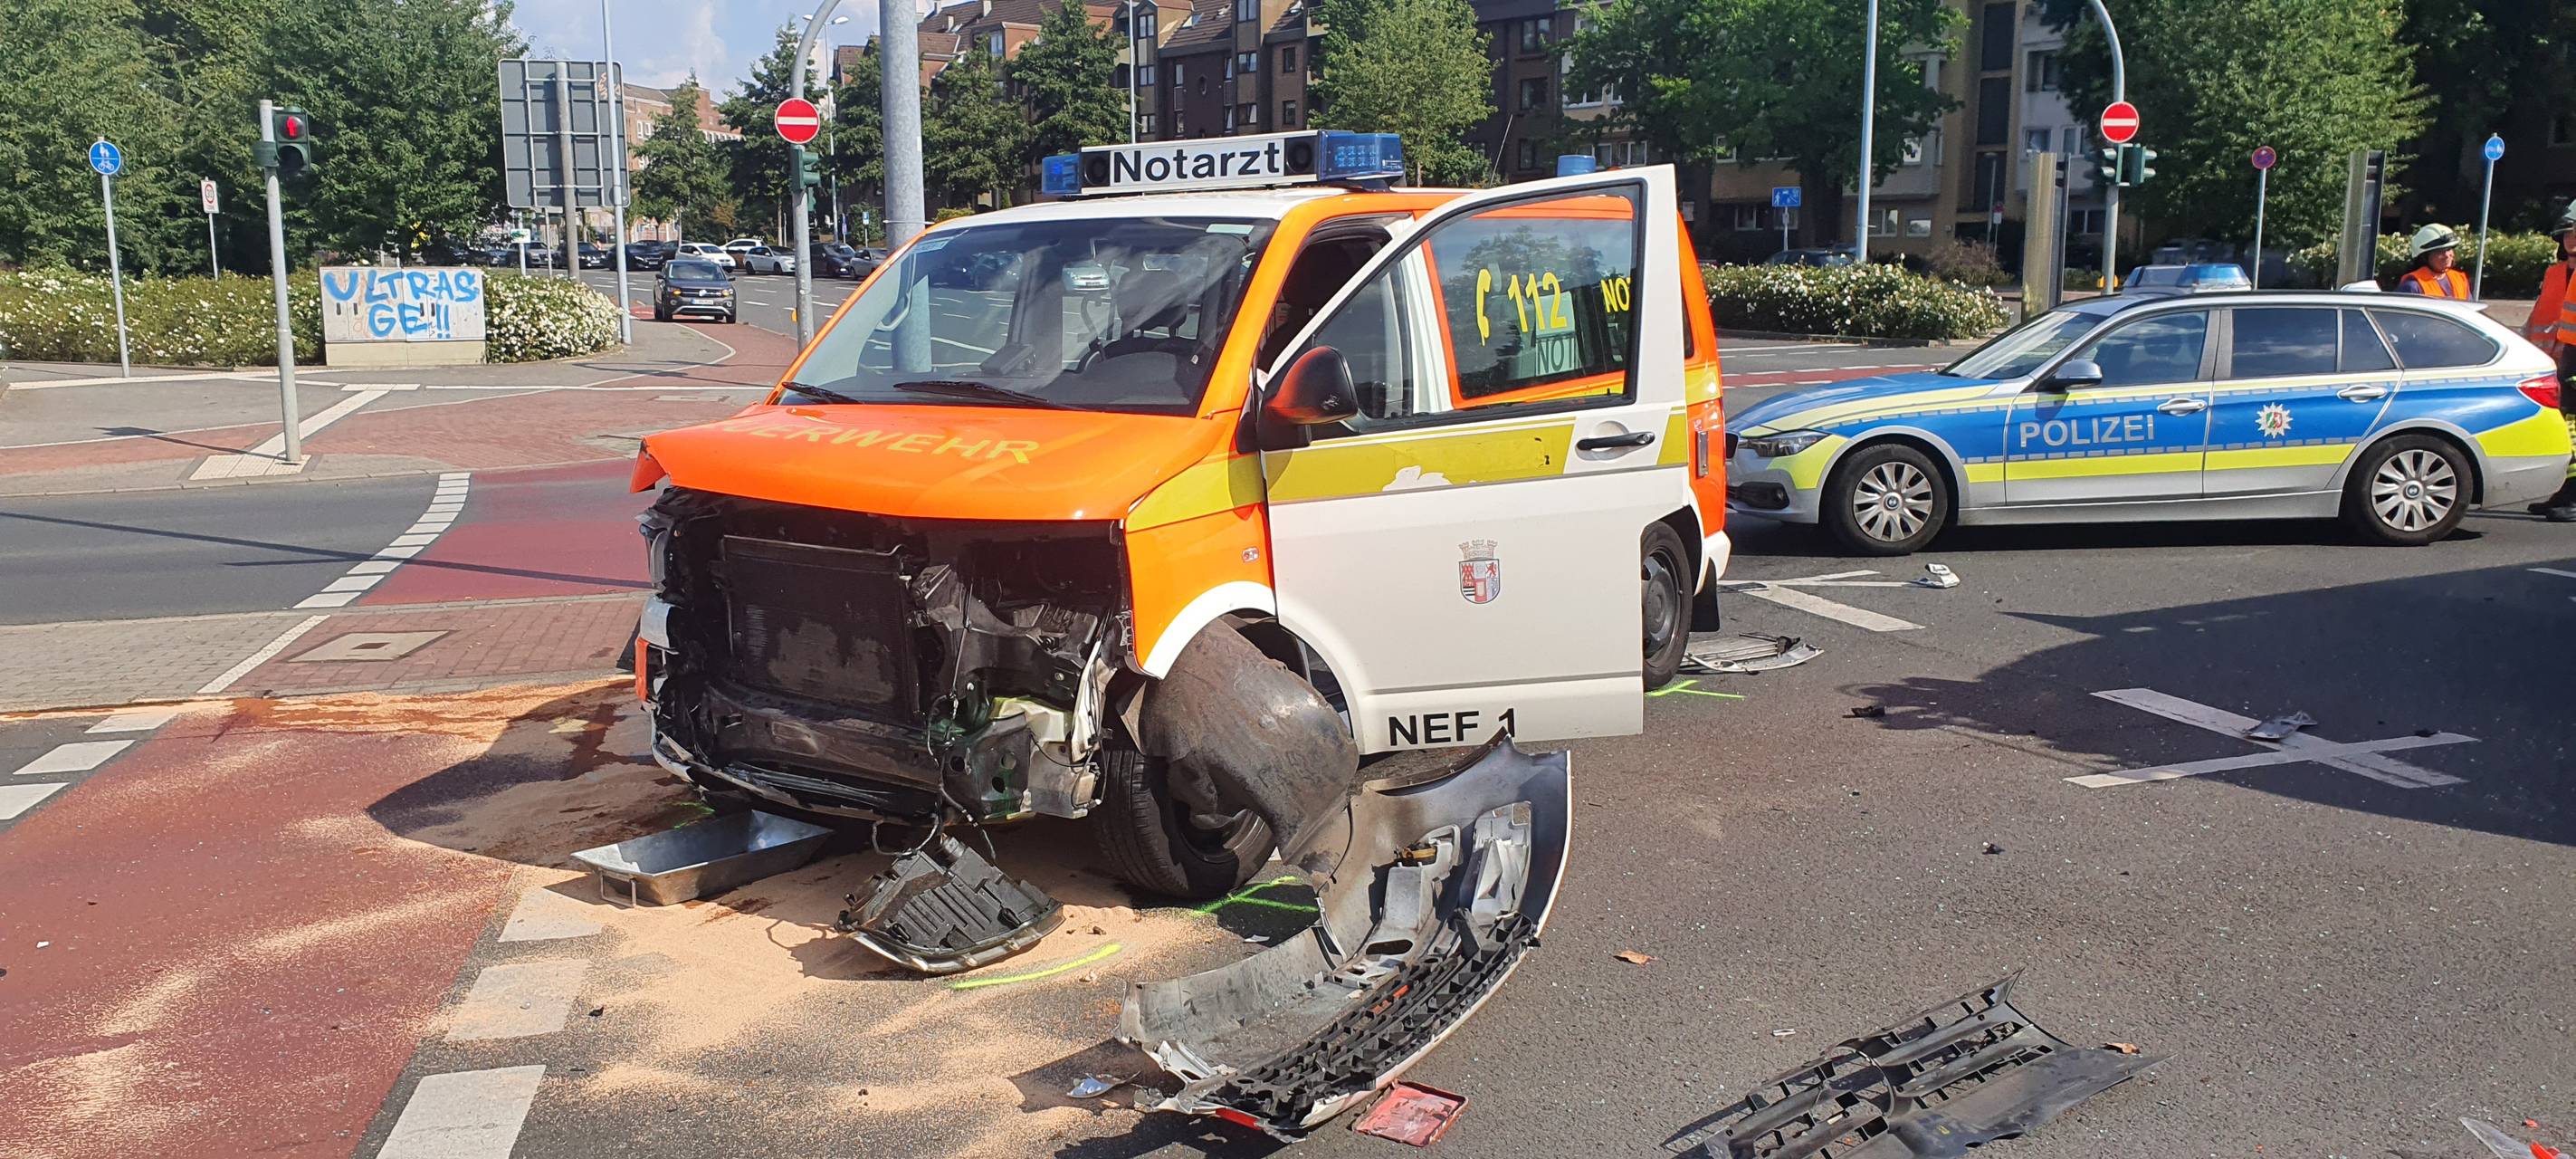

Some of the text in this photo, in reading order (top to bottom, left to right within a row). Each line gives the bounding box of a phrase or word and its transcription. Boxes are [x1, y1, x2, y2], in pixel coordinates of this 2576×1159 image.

[1113, 142, 1280, 183] Notarzt
[322, 269, 480, 303] ULTRAS
[1507, 272, 1568, 333] 112
[1600, 274, 1631, 313] NO
[368, 302, 451, 340] GE!!
[721, 423, 1040, 465] UERWEHR
[2019, 415, 2155, 448] POLIZEI
[1388, 708, 1516, 747] NEF 1
